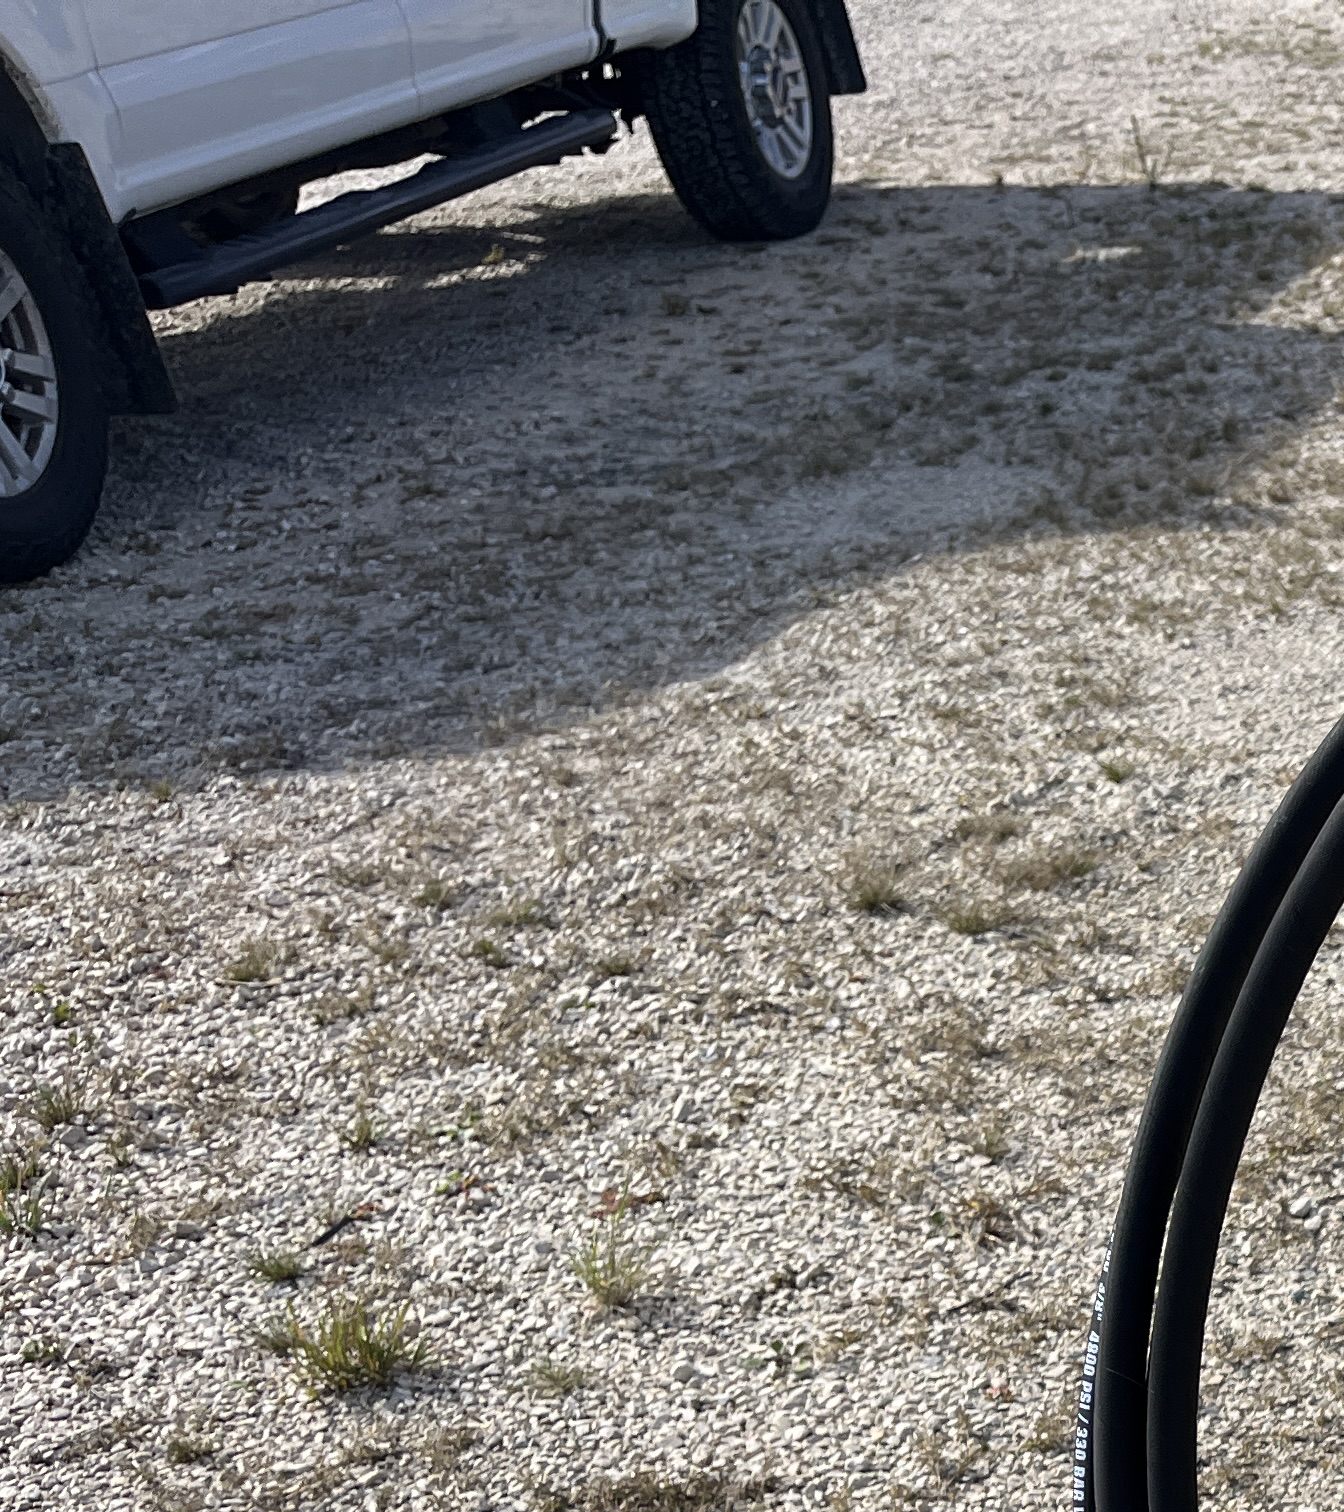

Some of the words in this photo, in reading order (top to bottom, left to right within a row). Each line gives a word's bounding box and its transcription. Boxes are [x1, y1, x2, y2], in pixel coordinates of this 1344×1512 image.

[1083, 1330, 1100, 1377] 4800
[1079, 1381, 1094, 1414] PSI
[1075, 1426, 1089, 1461] 330
[1073, 1466, 1086, 1501] BAR
